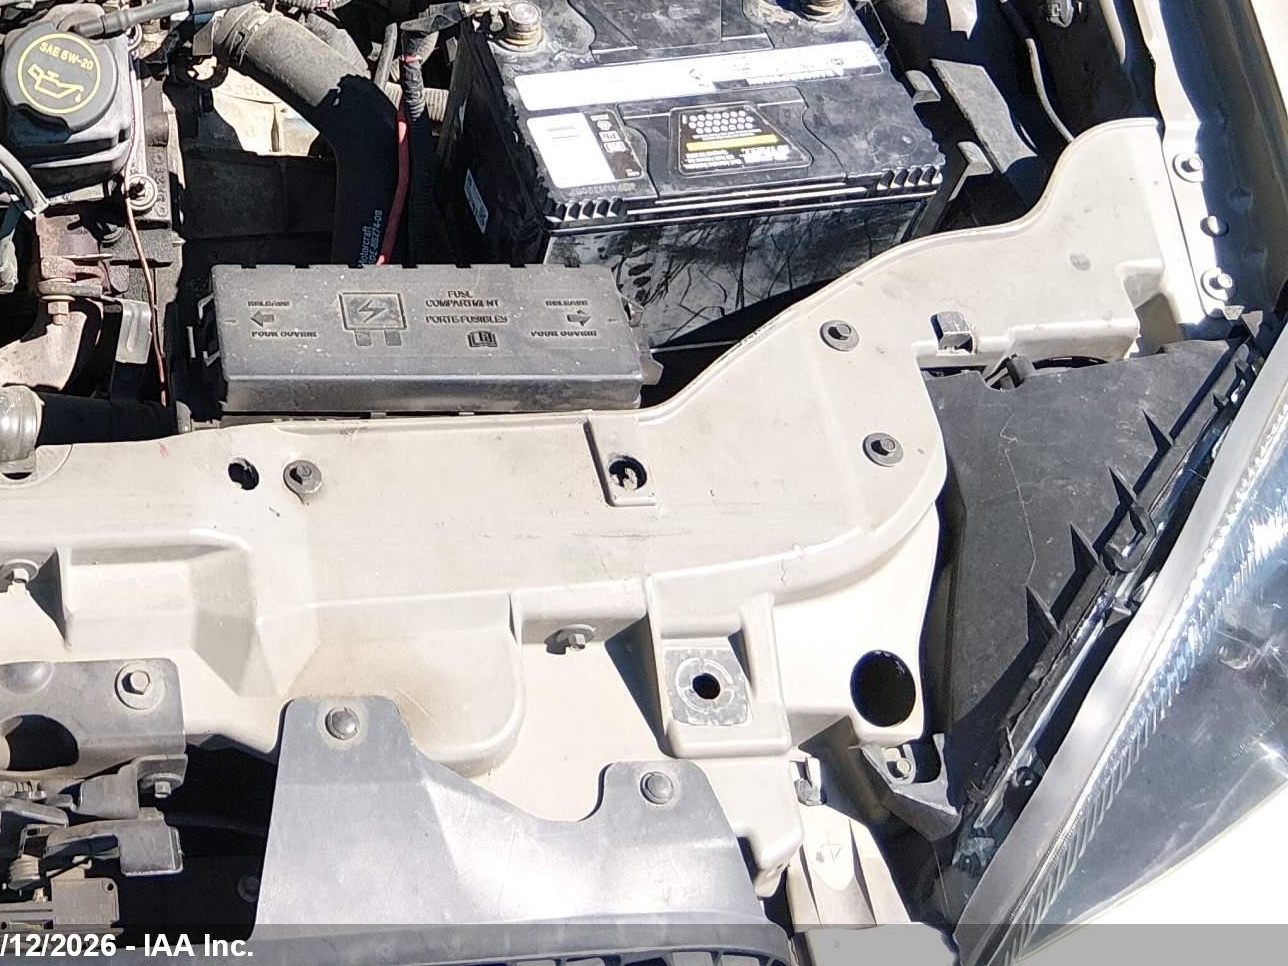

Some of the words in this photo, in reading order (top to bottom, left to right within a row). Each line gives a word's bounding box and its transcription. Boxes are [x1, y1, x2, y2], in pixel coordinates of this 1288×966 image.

[39, 41, 62, 58] SAE
[60, 49, 94, 71] 5W-20
[447, 290, 472, 298] FUSE
[425, 299, 500, 307] COMPARTMENT
